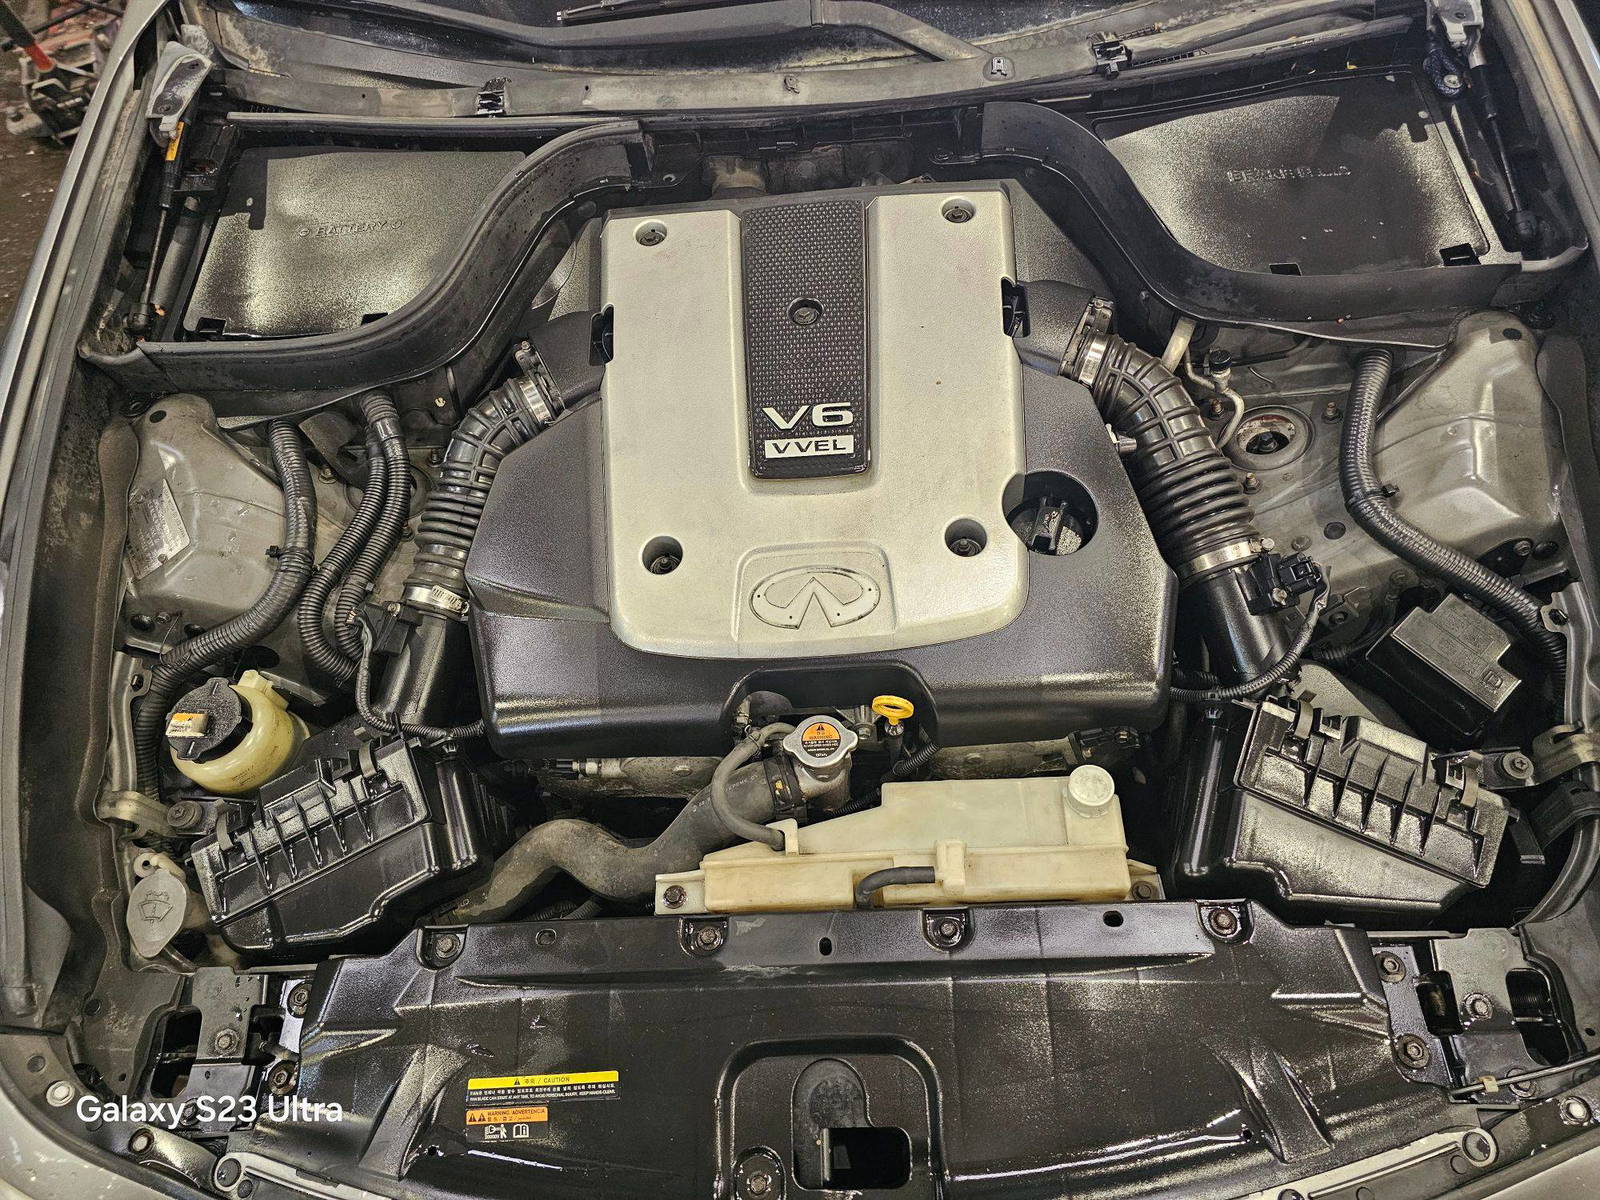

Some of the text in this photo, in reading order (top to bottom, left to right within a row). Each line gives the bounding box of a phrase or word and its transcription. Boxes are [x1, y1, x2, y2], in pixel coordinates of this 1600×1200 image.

[316, 221, 388, 237] BATTERY
[762, 402, 854, 430] V6
[772, 439, 847, 454] VVEL
[543, 1076, 570, 1084] CAUTION
